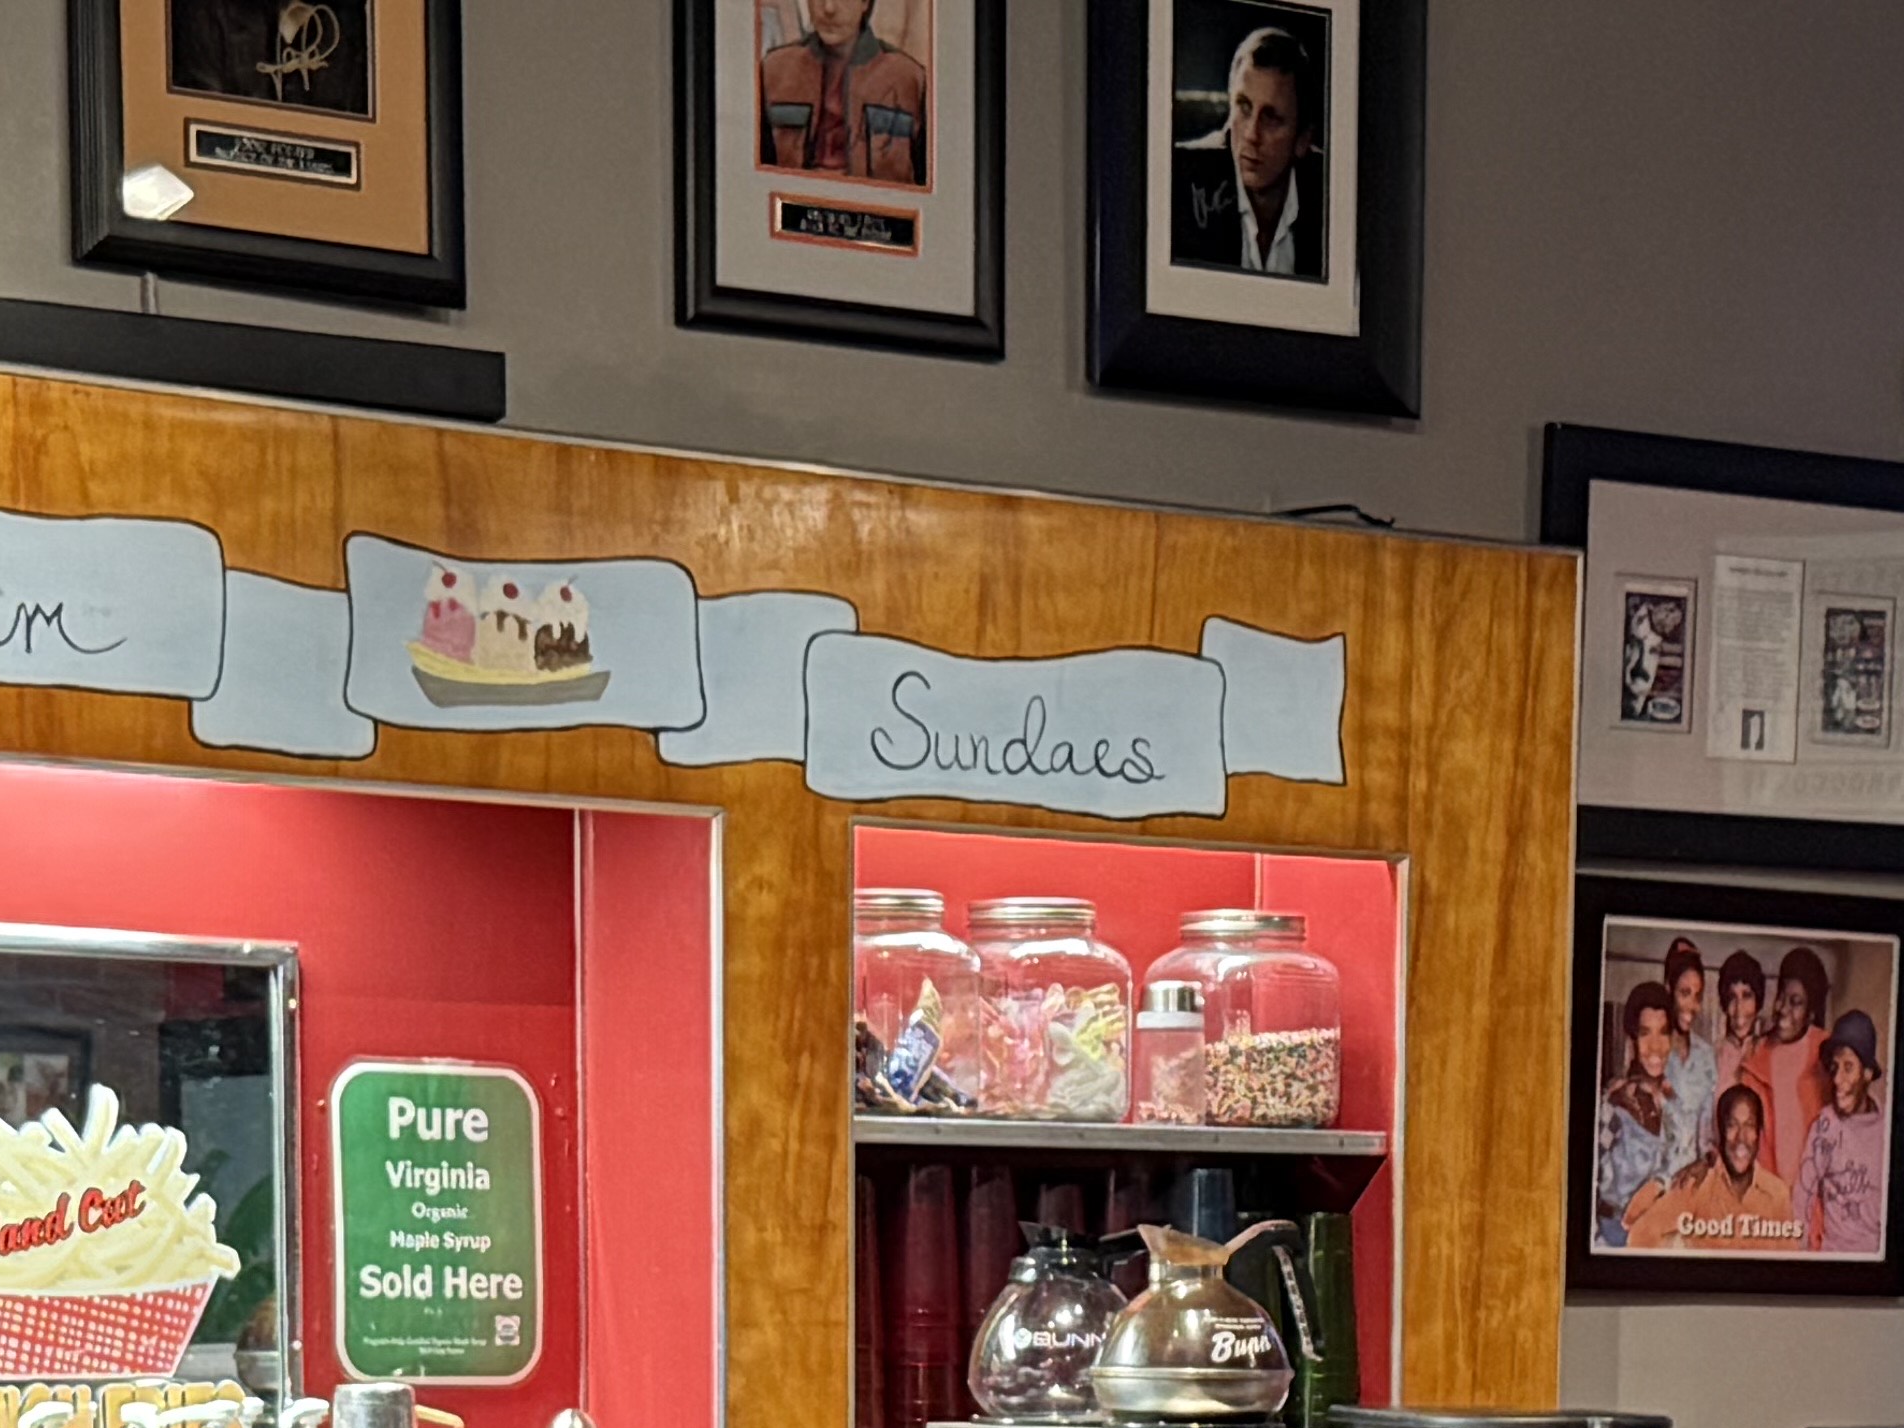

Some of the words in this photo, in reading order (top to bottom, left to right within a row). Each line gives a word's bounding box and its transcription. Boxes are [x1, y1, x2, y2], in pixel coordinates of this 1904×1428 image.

[871, 670, 1166, 784] Sundaes
[387, 1097, 490, 1145] Pure
[386, 1159, 491, 1196] Virginia
[78, 1179, 146, 1236] Cut
[411, 1201, 469, 1223] Organic
[1678, 1211, 1734, 1237] Good
[1738, 1213, 1804, 1239] Times
[389, 1230, 440, 1252] Maple
[443, 1231, 491, 1253] Syrup
[359, 1263, 433, 1300] Sold
[443, 1265, 523, 1300] Here
[1210, 1330, 1273, 1368] Bunn
